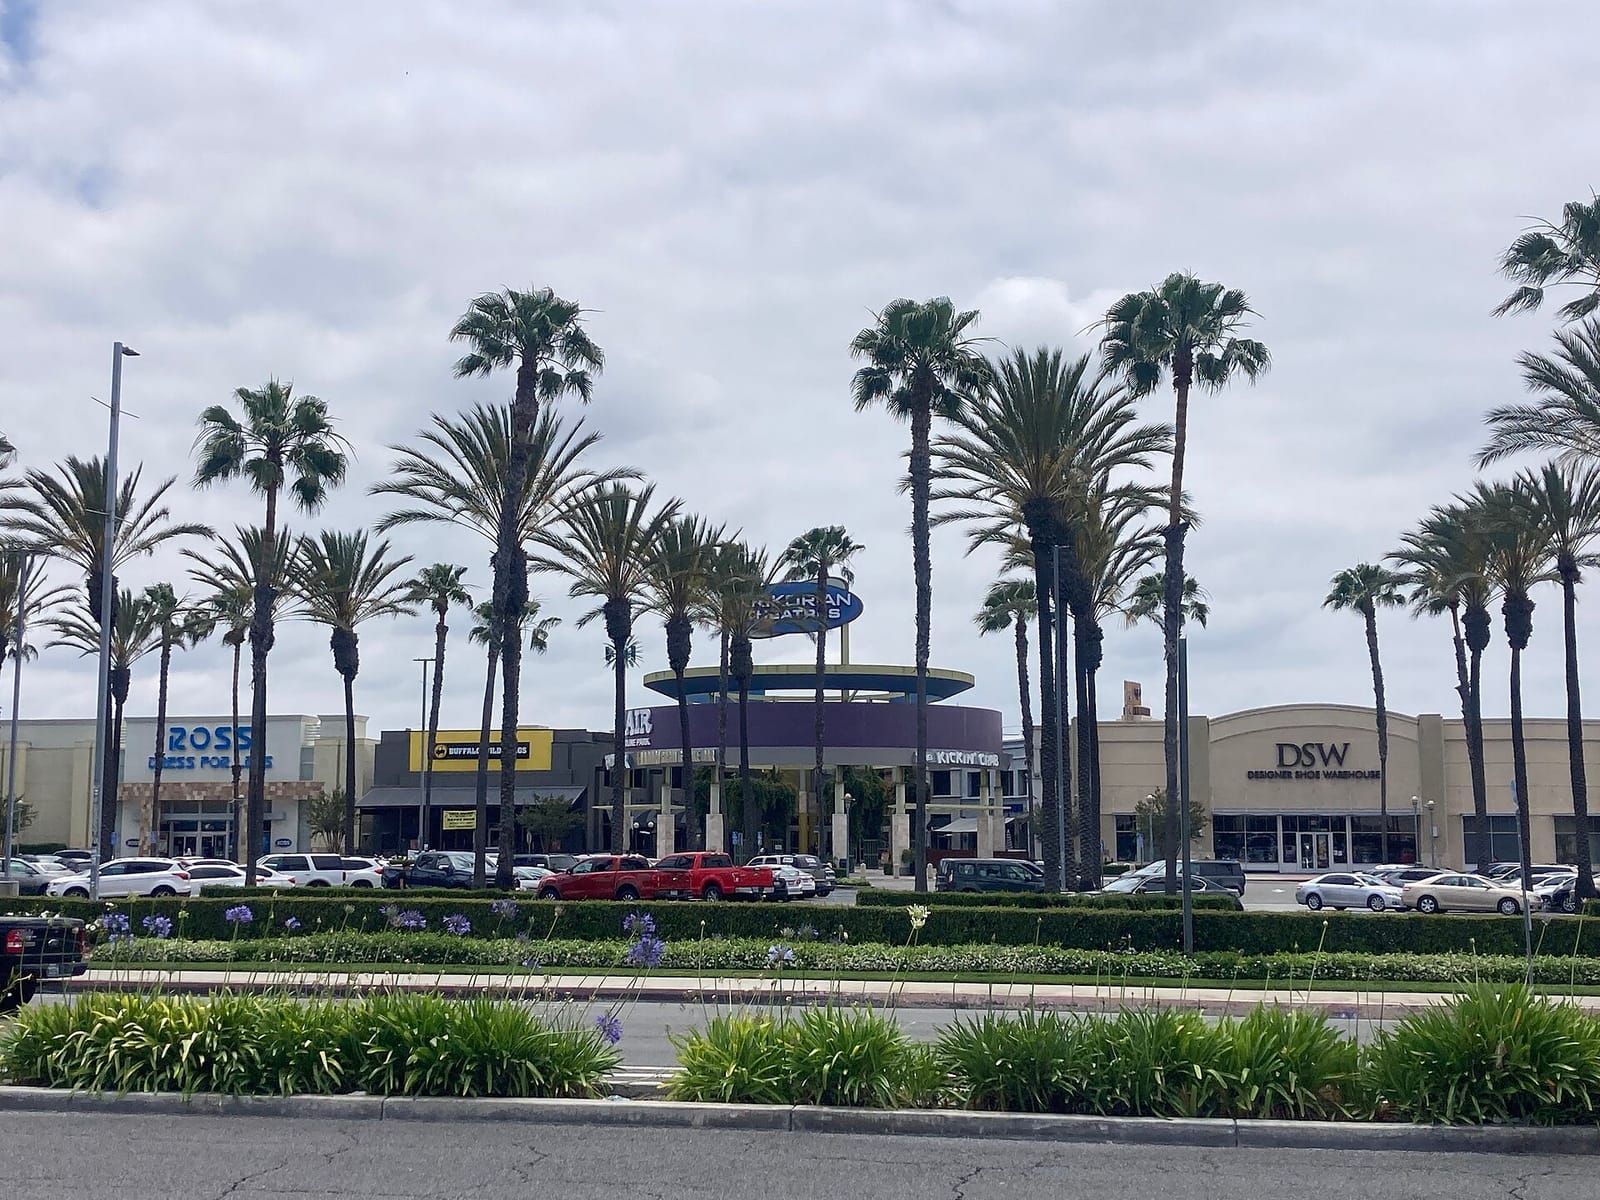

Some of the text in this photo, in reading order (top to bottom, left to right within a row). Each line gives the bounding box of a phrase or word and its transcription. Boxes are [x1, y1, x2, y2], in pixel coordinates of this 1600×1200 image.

[751, 593, 851, 608] RKORAN
[752, 608, 841, 620] HEATRS
[625, 708, 653, 736] AIR
[168, 726, 252, 751] ROSS
[487, 746, 502, 755] ILD
[1275, 742, 1350, 768] DSW
[200, 756, 230, 770] FOR
[1247, 770, 1381, 780] DESIGNER SHOE WAREHOUSE
